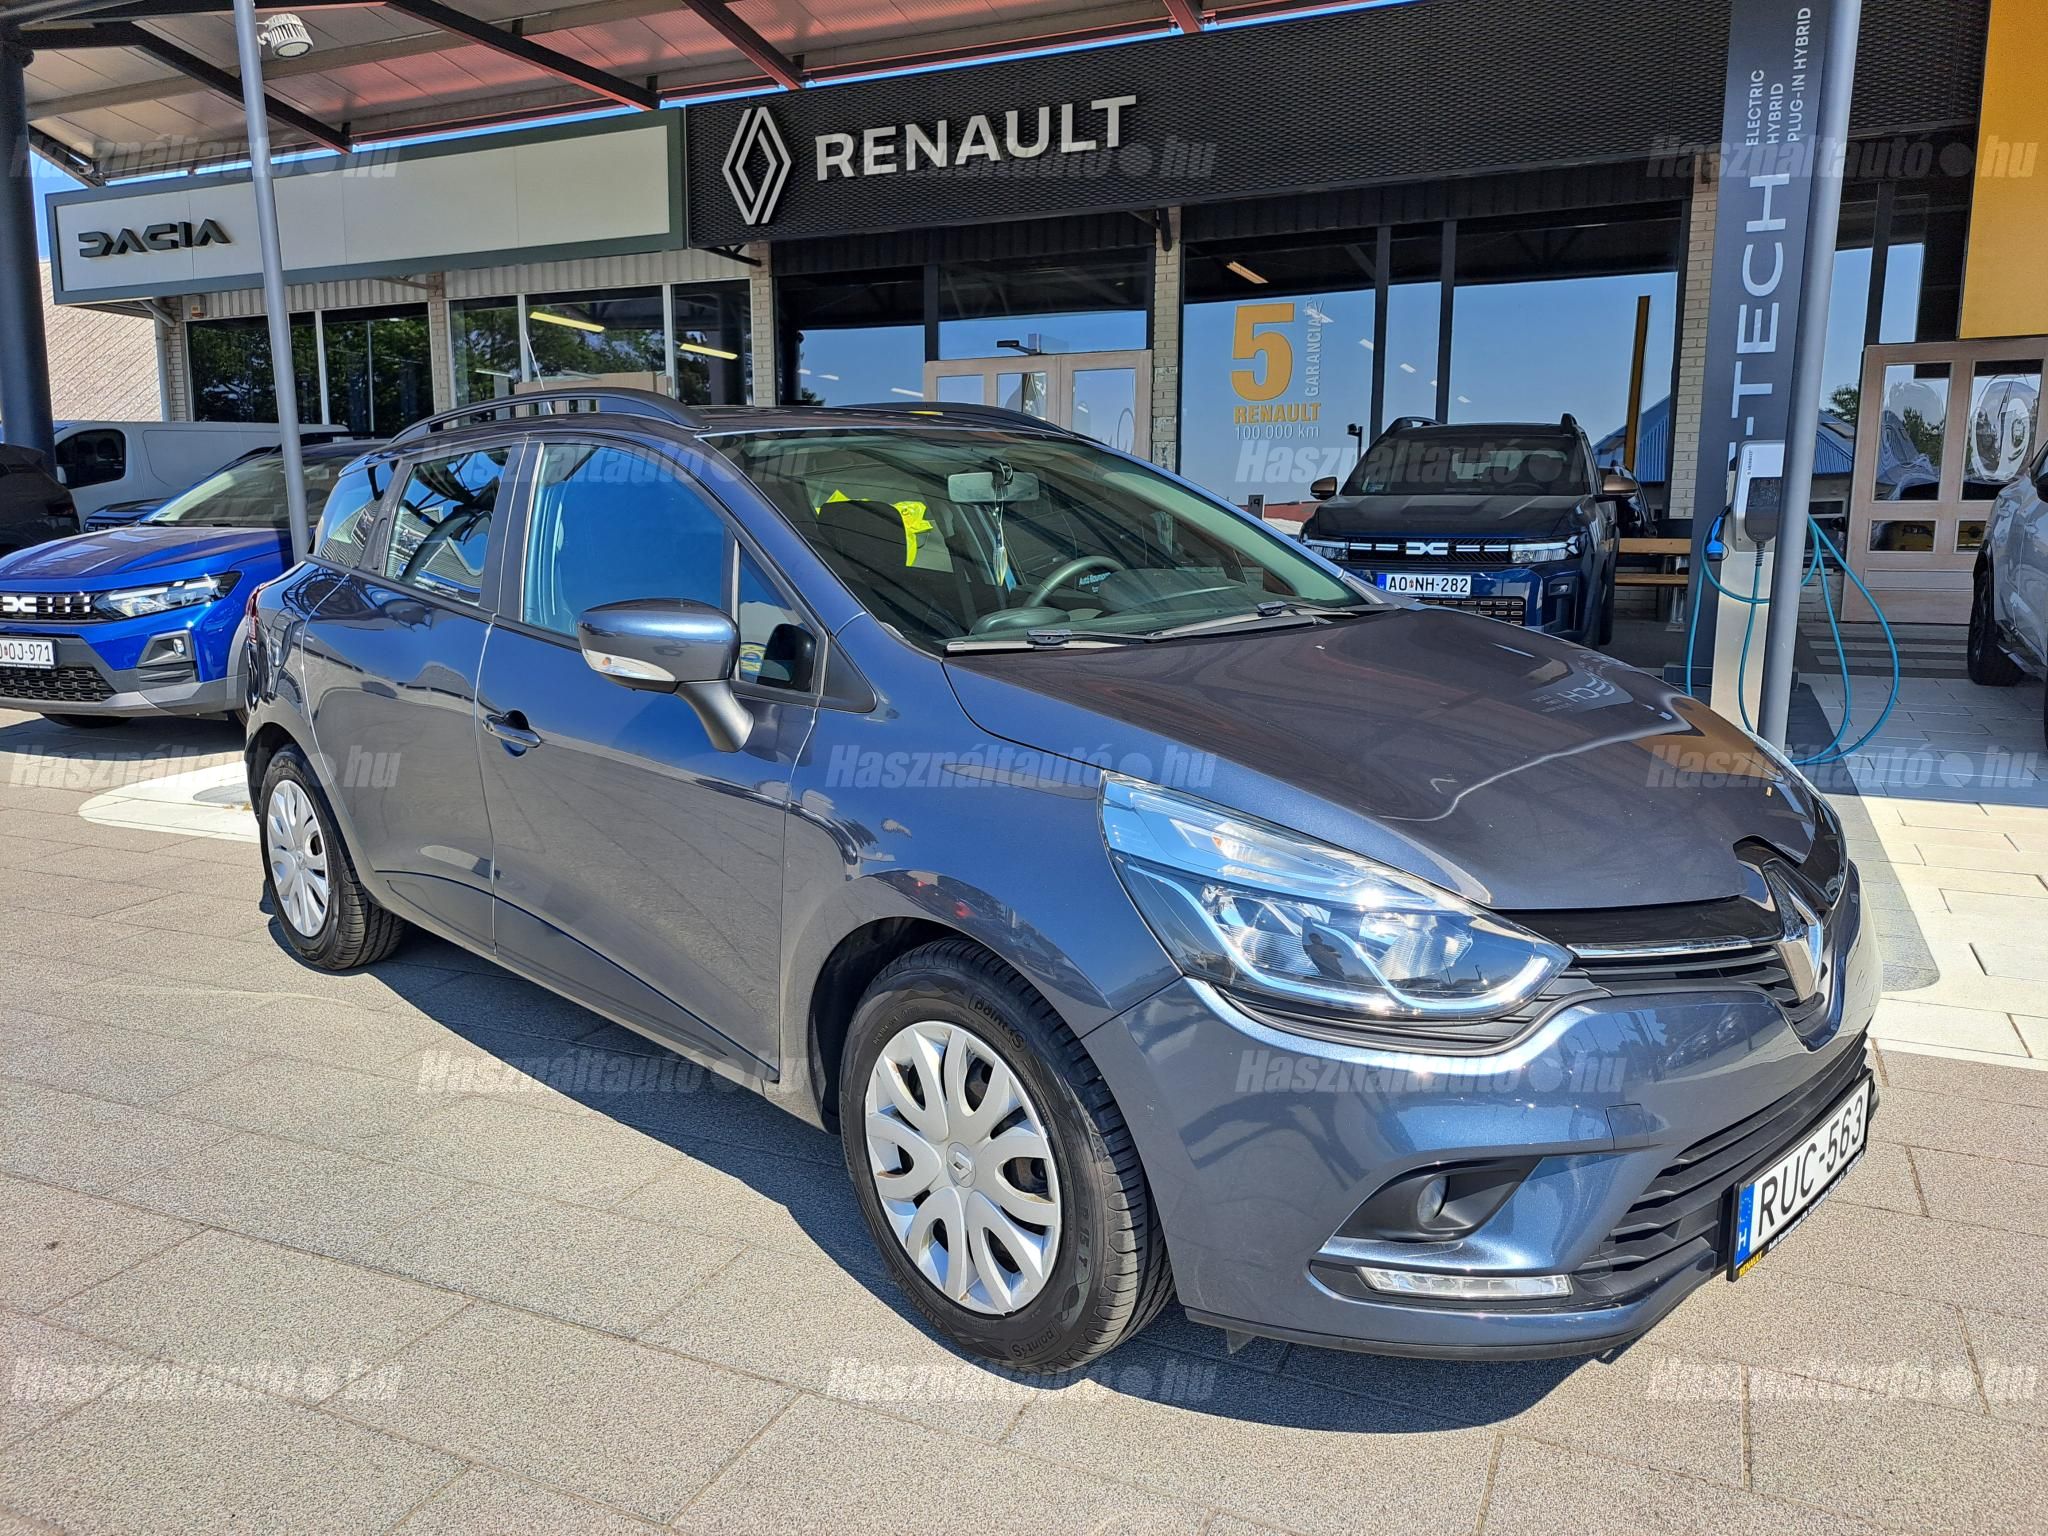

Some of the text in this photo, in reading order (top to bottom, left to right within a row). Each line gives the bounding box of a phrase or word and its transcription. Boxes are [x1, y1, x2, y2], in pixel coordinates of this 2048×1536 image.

[1745, 69, 1765, 147] ELECTRIC
[1766, 82, 1784, 145] HYBRID
[1787, 7, 1812, 143] PLUG-IN HYBRID
[815, 95, 1137, 181] RENAULT
[78, 218, 232, 258] DACIA
[1231, 303, 1295, 401] 5
[1304, 316, 1322, 397] GARANCIA
[1728, 173, 1790, 489] -TECH
[1234, 402, 1321, 424] RENAULT
[1235, 423, 1320, 440] 100 000 km
[1415, 577, 1468, 592] NH-282
[1758, 1095, 1863, 1237] RUC-563
[1738, 1227, 1748, 1252] H
